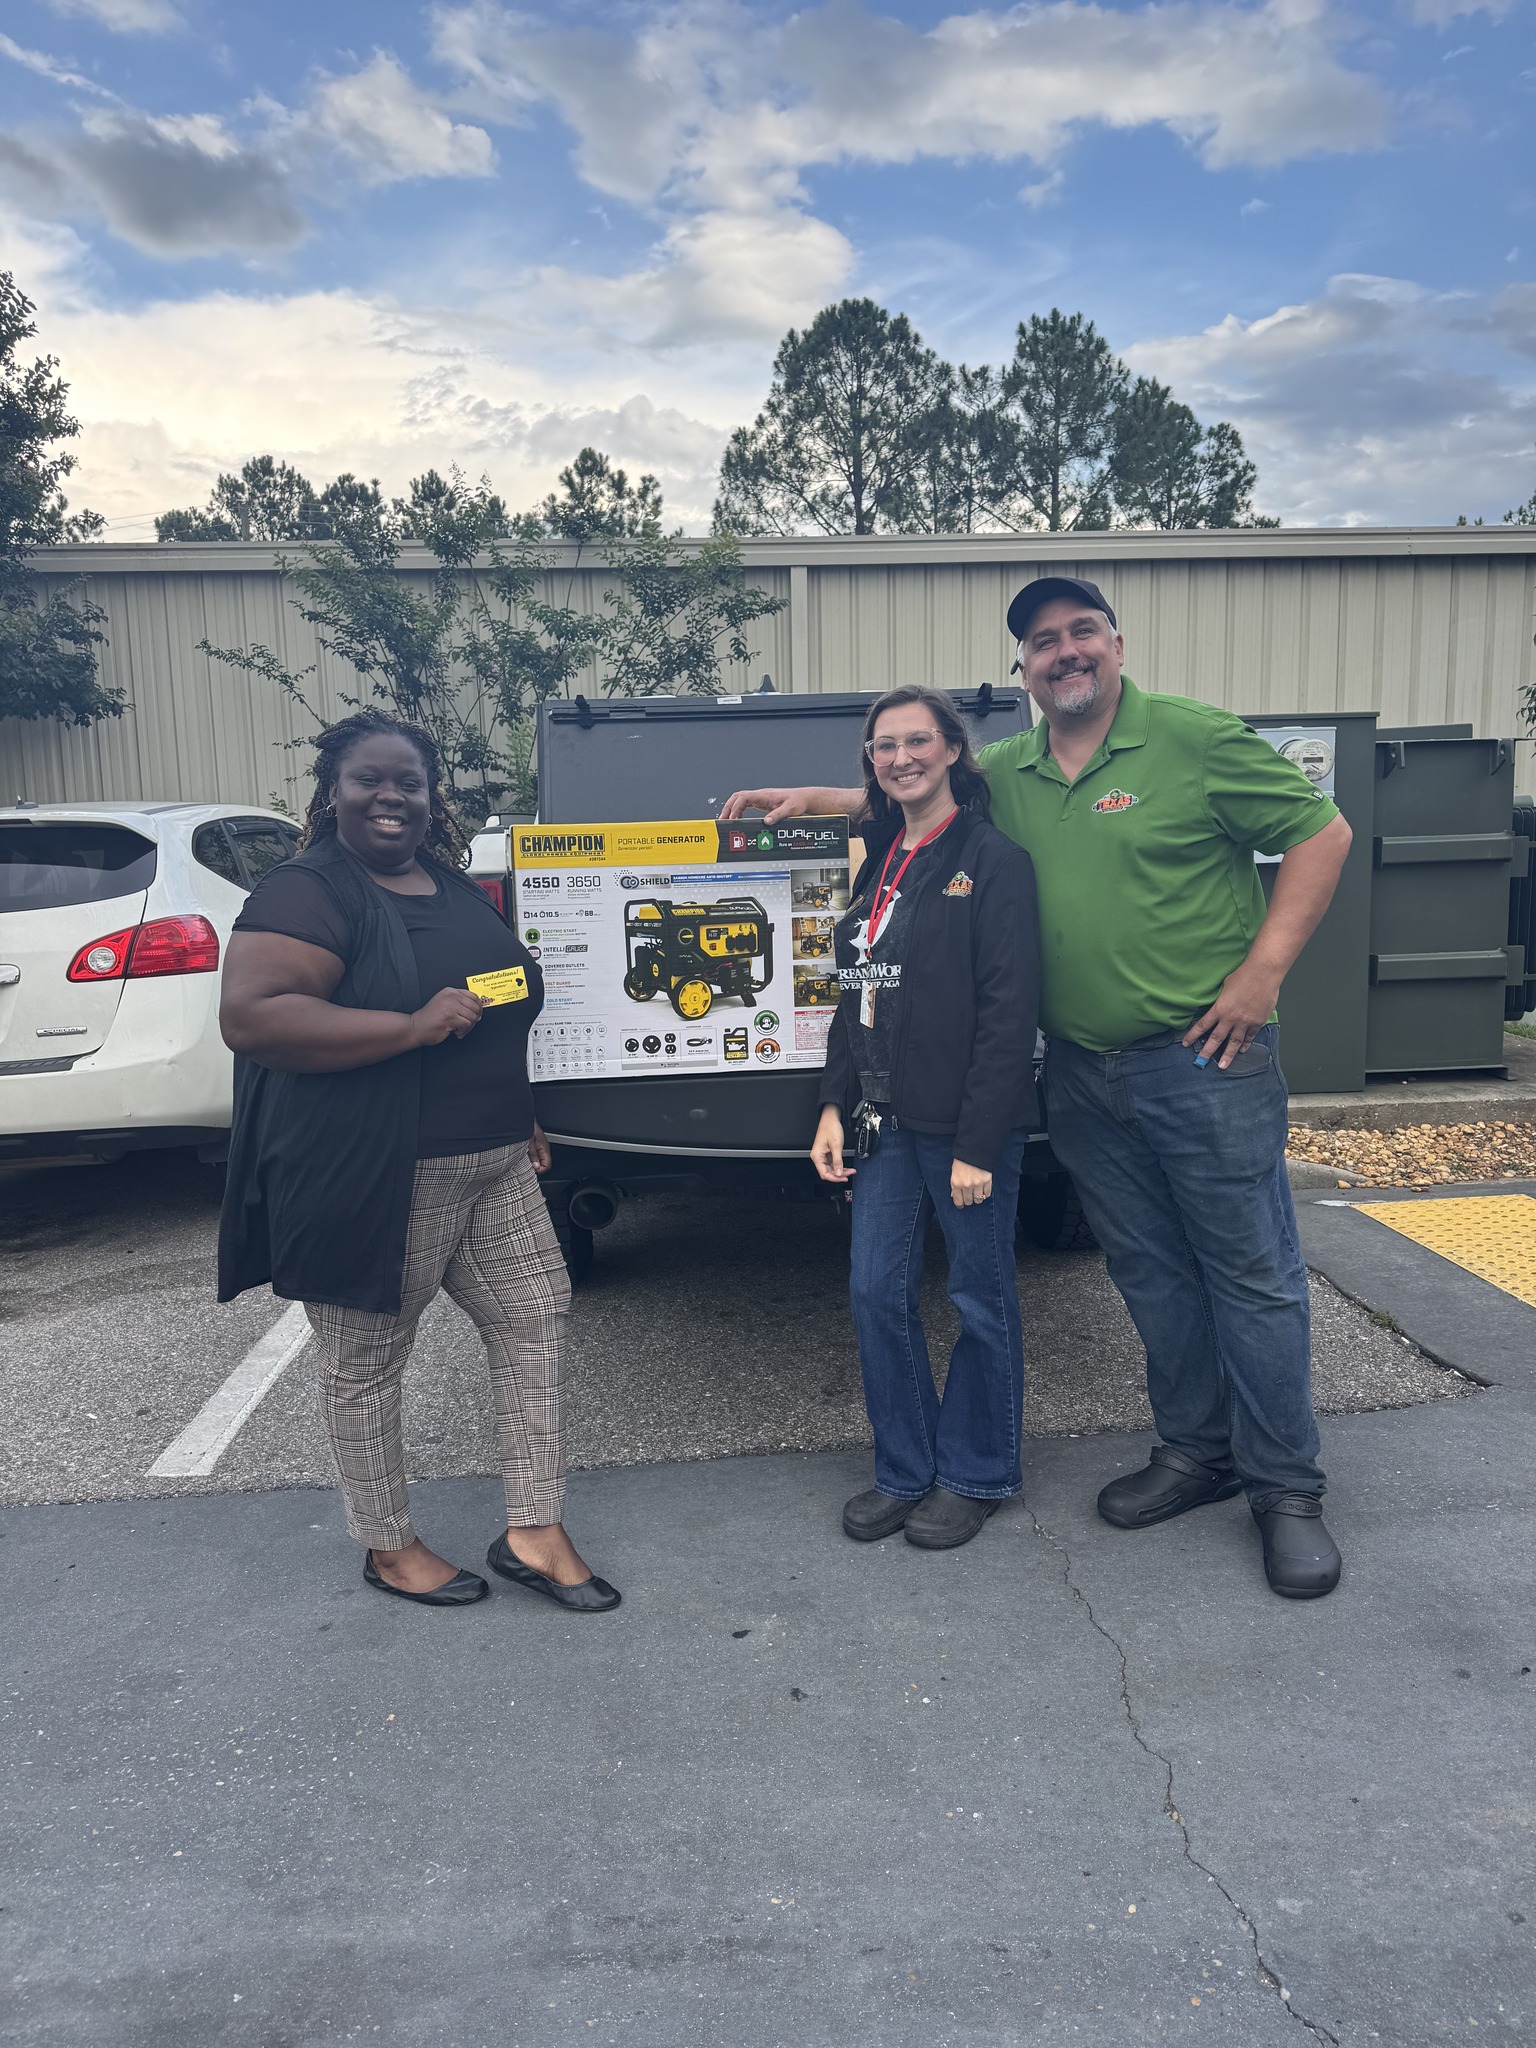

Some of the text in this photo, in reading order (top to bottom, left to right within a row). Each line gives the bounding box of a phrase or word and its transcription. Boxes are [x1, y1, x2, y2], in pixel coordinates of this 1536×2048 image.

[520, 834, 605, 852] CHAMPION
[656, 835, 706, 844] GENERATOR
[522, 877, 560, 889] 4550
[567, 875, 601, 888] 3650
[640, 877, 670, 886] SHIELD
[472, 969, 519, 983] Congratulations!
[838, 963, 901, 980] REAMWOR
[839, 982, 861, 990] EVER
[883, 980, 899, 988] AGA
[763, 1044, 772, 1055] 3
